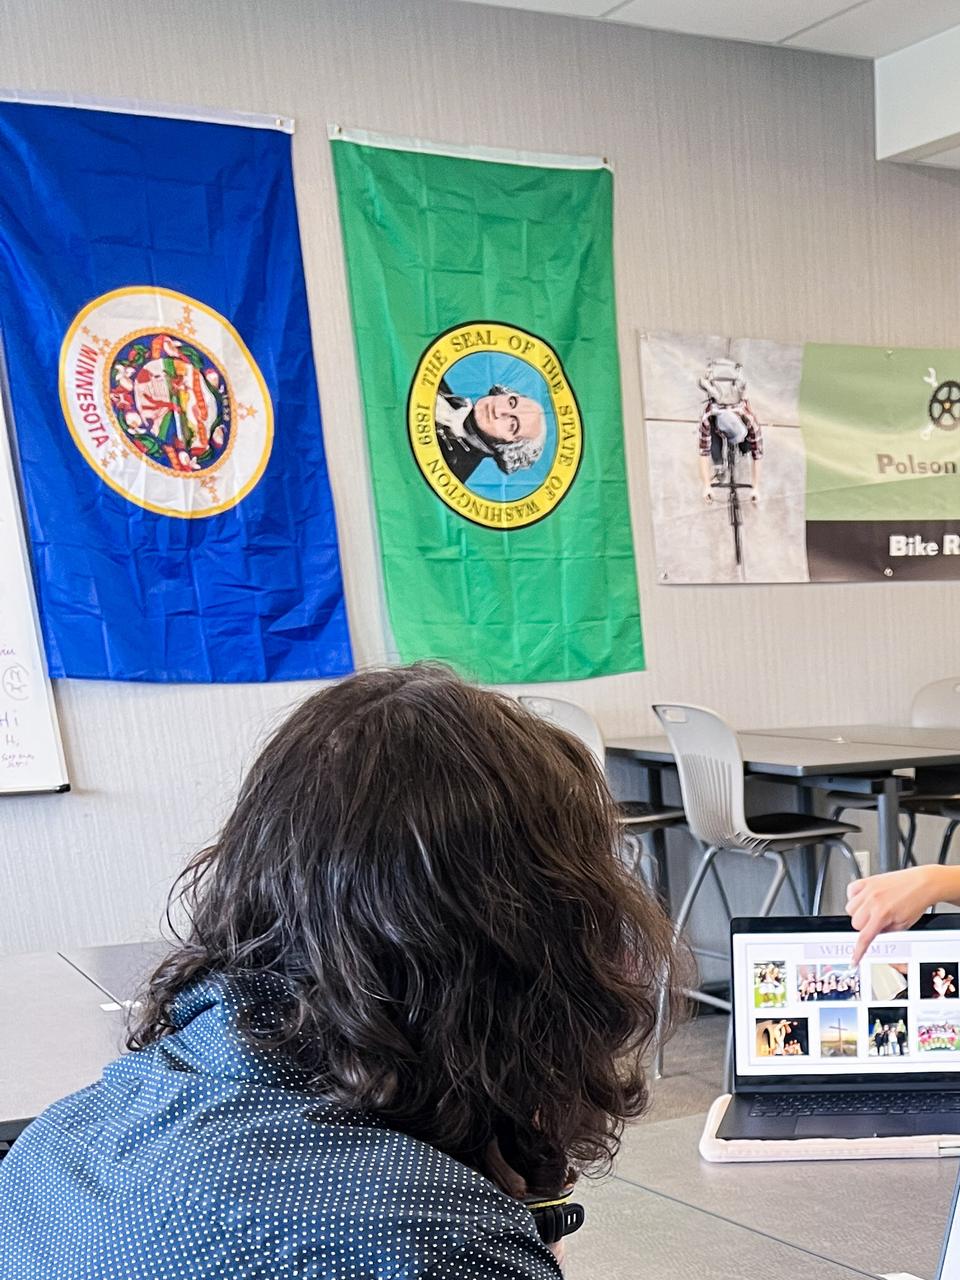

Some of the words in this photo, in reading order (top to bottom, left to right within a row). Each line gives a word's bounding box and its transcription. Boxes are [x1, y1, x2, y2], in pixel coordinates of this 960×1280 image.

[451, 330, 498, 353] SEAL
[508, 335, 536, 354] OF
[421, 349, 448, 387] THE
[542, 354, 565, 394] THE
[74, 344, 110, 448] MINNESOTA
[416, 404, 433, 445] 1889
[558, 404, 576, 467] STATE
[876, 453, 957, 474] Polson
[427, 459, 540, 522] WASHINGTON
[545, 475, 563, 500] OF
[889, 535, 939, 557] Bike
